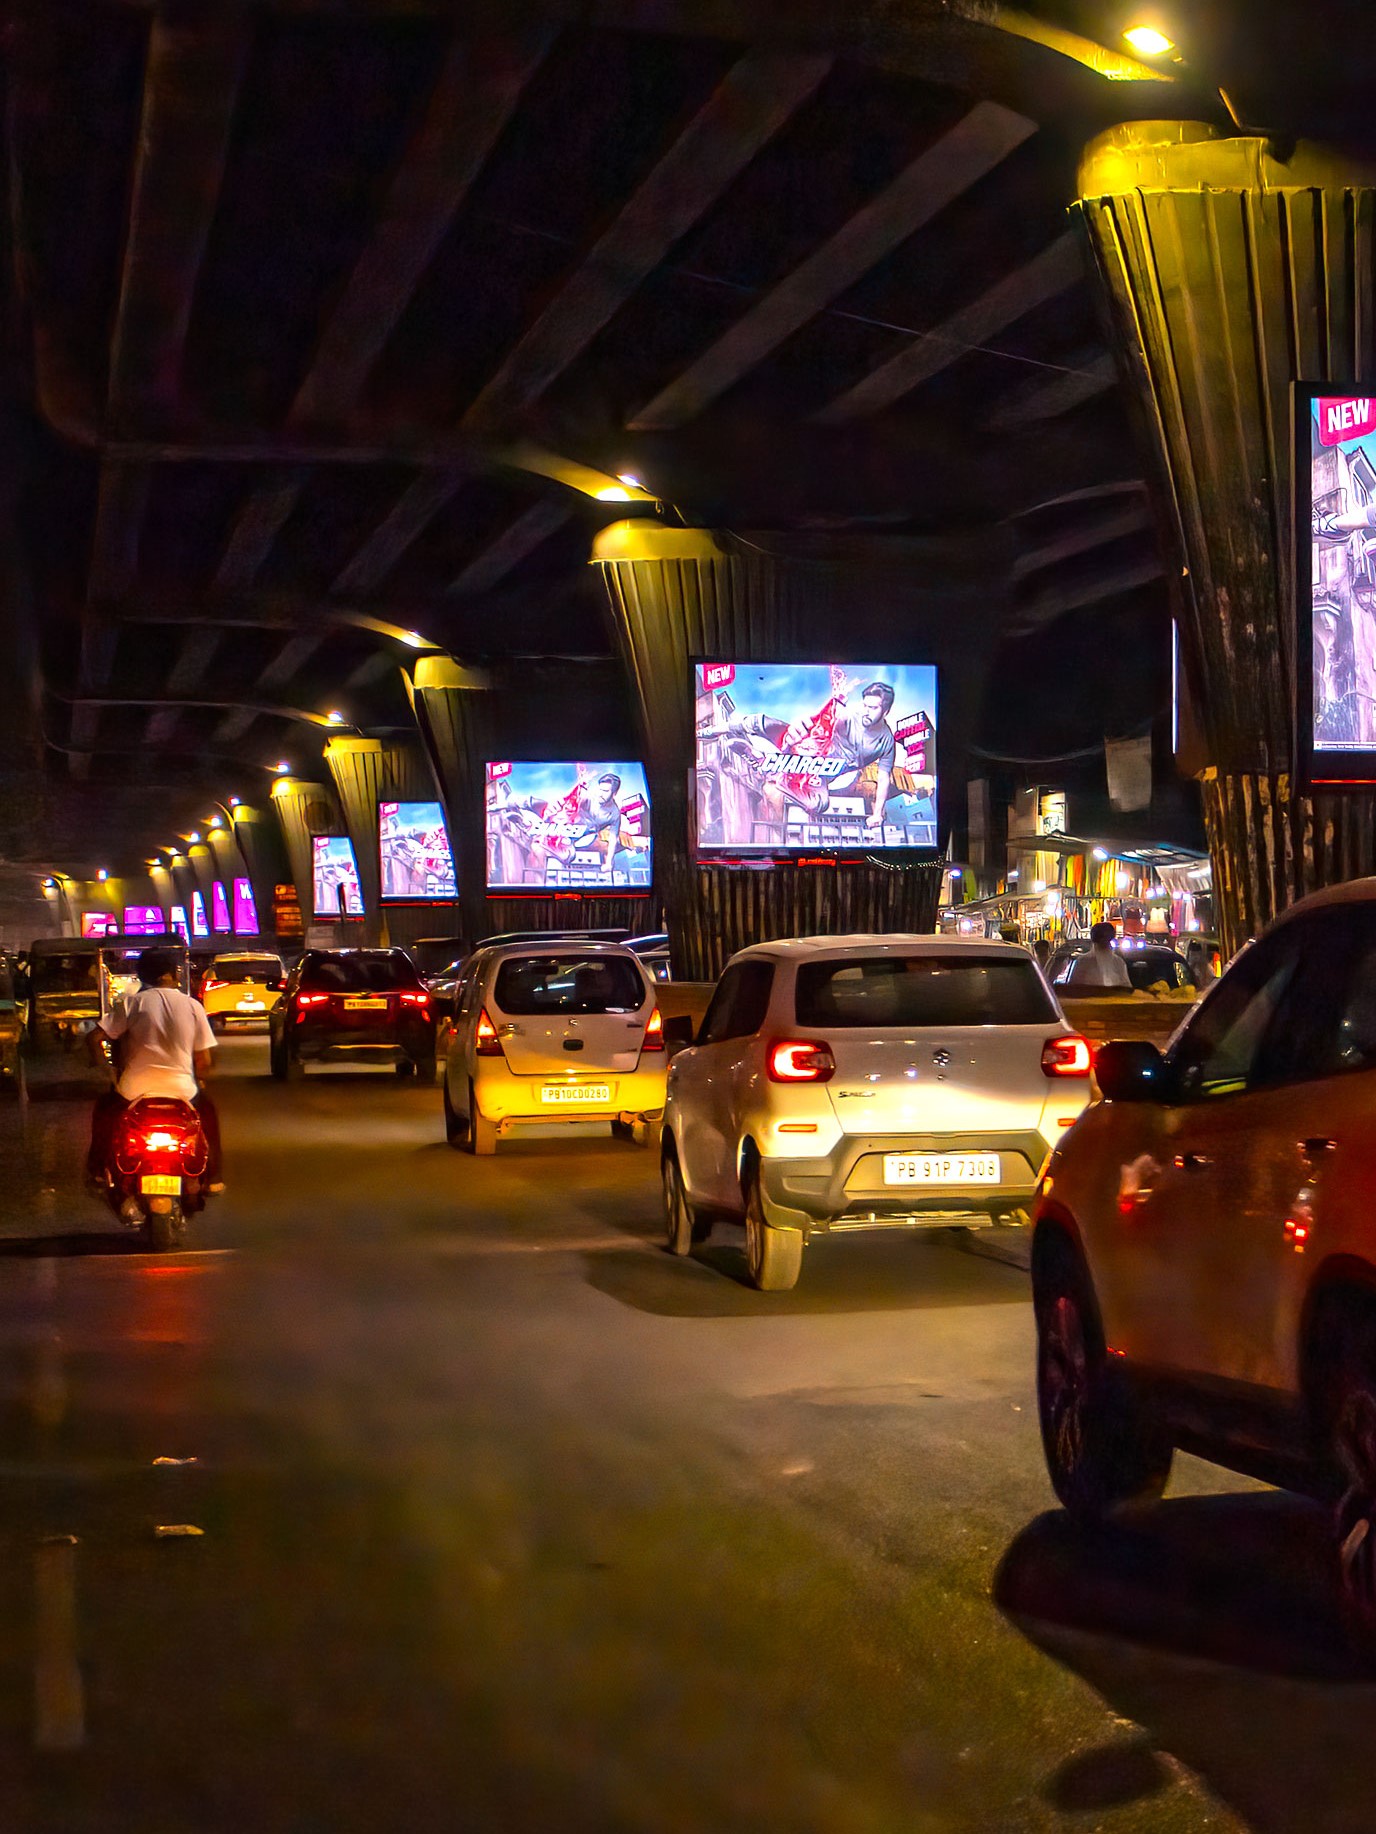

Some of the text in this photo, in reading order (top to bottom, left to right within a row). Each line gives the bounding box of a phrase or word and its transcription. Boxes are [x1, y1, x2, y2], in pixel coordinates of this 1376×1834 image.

[1327, 398, 1370, 433] NEW
[706, 665, 731, 685] NEW
[761, 752, 847, 777] CHARGED
[898, 1160, 995, 1178] PB 91P 7308
